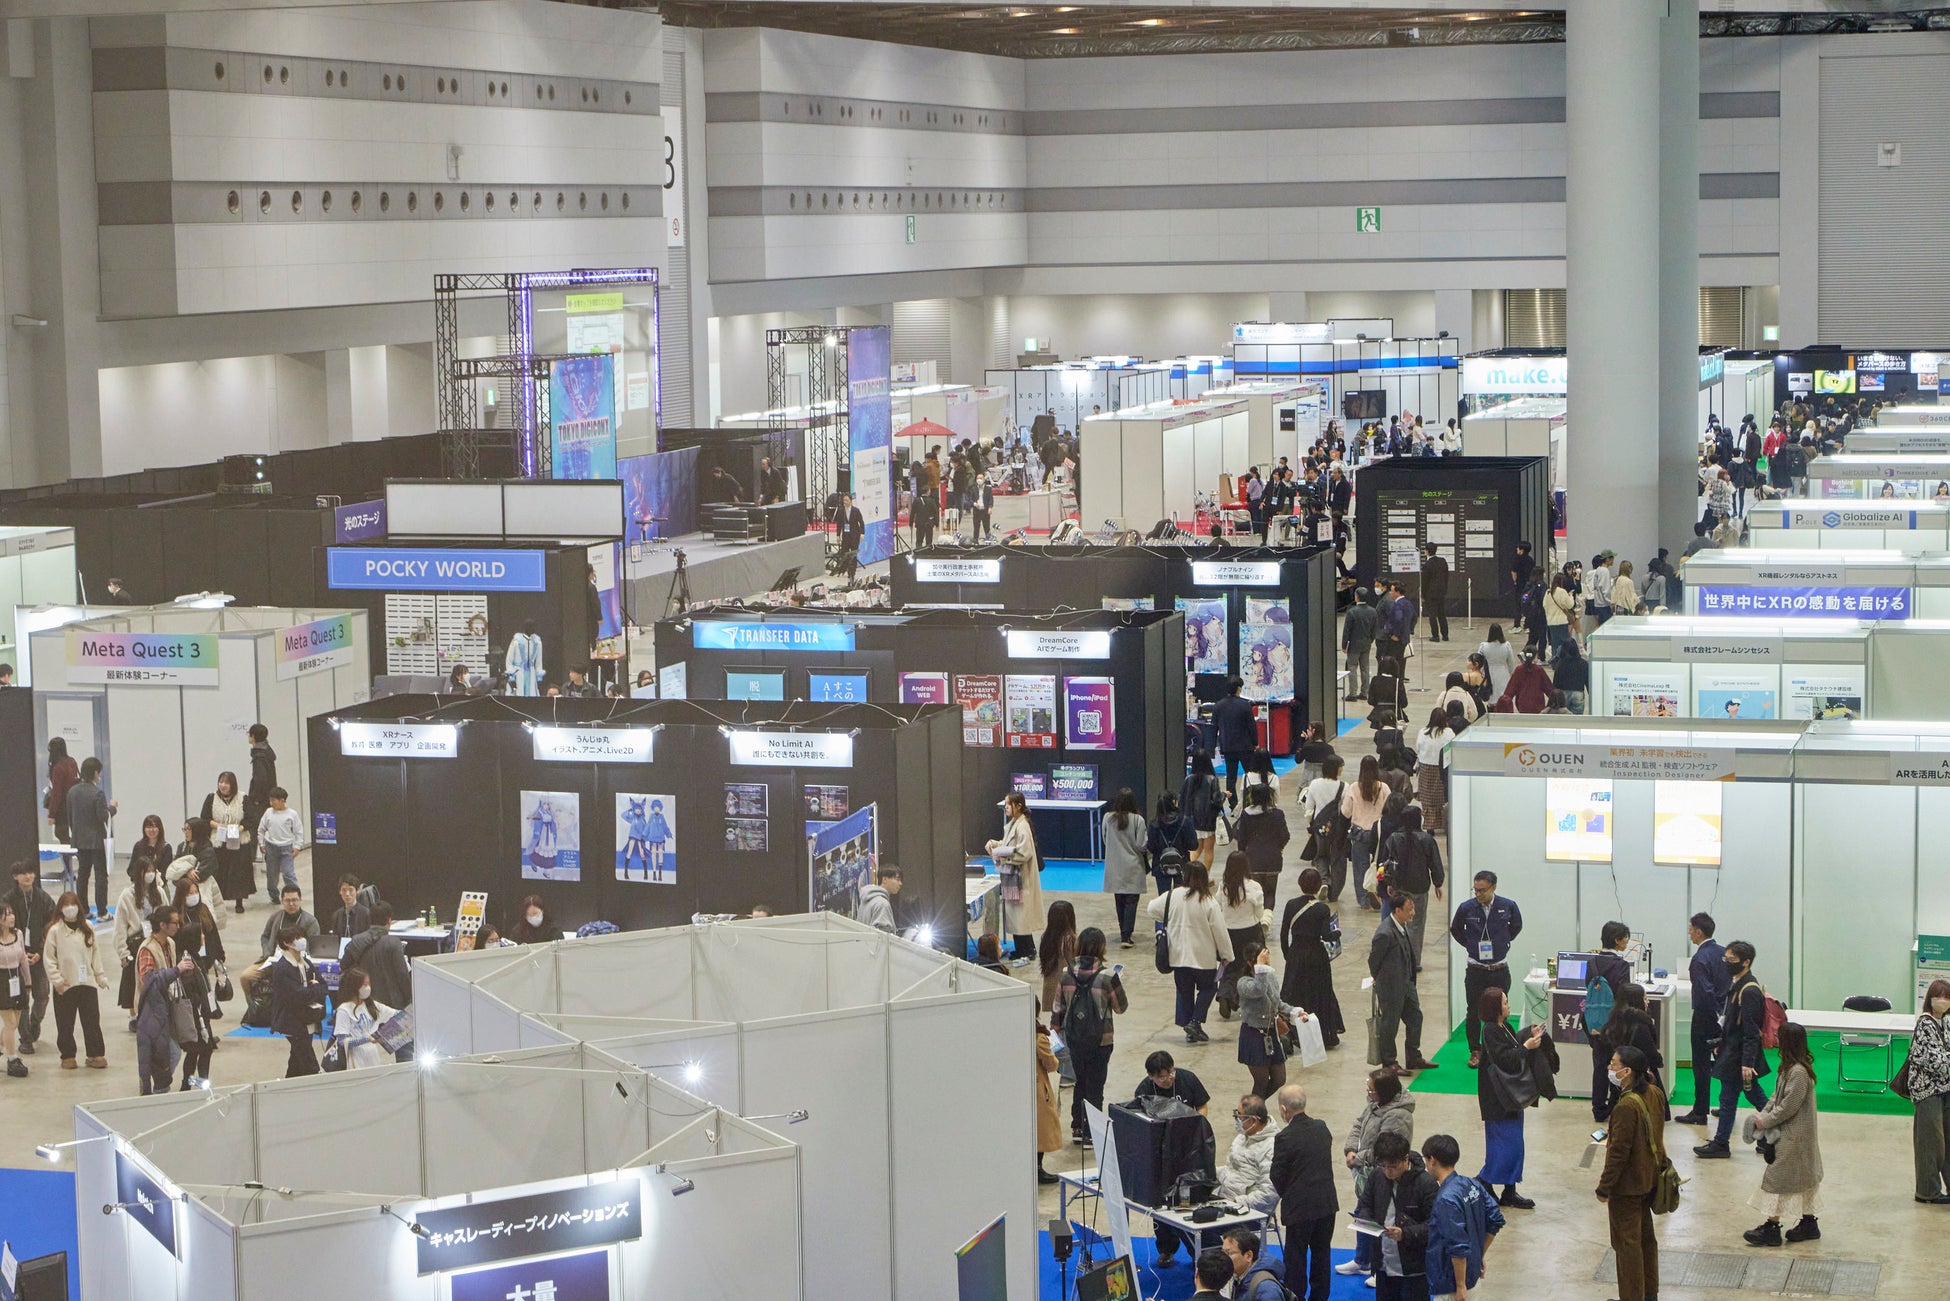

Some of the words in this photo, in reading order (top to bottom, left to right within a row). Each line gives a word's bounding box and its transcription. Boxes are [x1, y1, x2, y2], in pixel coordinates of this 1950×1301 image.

[558, 421, 580, 442] TOKYO
[344, 511, 380, 531] 光のステージ
[1843, 513, 1890, 521] Globalize
[1892, 513, 1903, 521] AI
[365, 560, 429, 577] POCKY
[435, 561, 506, 578] WORLD
[1704, 593, 1905, 611] 世界中にXRの感動を届ける
[285, 633, 309, 653] Meta
[310, 628, 337, 647] Quest
[338, 624, 345, 639] 3
[740, 629, 790, 643] TRANSFER
[794, 630, 819, 644] DATA
[82, 641, 125, 658] Meta
[132, 642, 184, 660] Quest
[190, 643, 201, 658] 3
[1037, 645, 1080, 653] AIでゲーム制作
[1683, 646, 1770, 655] 株式会社フレームシンセシス
[298, 656, 335, 672] 最新体験コーナー
[106, 670, 178, 681] 最新体験コーナー
[1070, 693, 1108, 701] iPhone/iPad
[382, 731, 414, 739] XRナース
[576, 735, 610, 744] うんじゅ丸
[390, 741, 410, 749] アプリ
[417, 742, 447, 750] 企画開発
[782, 740, 802, 748] Limit
[804, 740, 814, 748] AI
[1609, 748, 1634, 756] 業界初
[1539, 753, 1584, 765] OUEN
[1600, 760, 1630, 769] 統合生成
[1631, 761, 1640, 769] AI
[1613, 770, 1661, 778] Inspection
[1665, 771, 1705, 779] Designer
[1013, 784, 1044, 792] ¥100,000
[1052, 779, 1094, 789] ¥500,000
[430, 1200, 630, 1248] キャスレーディープイノベーションズ
